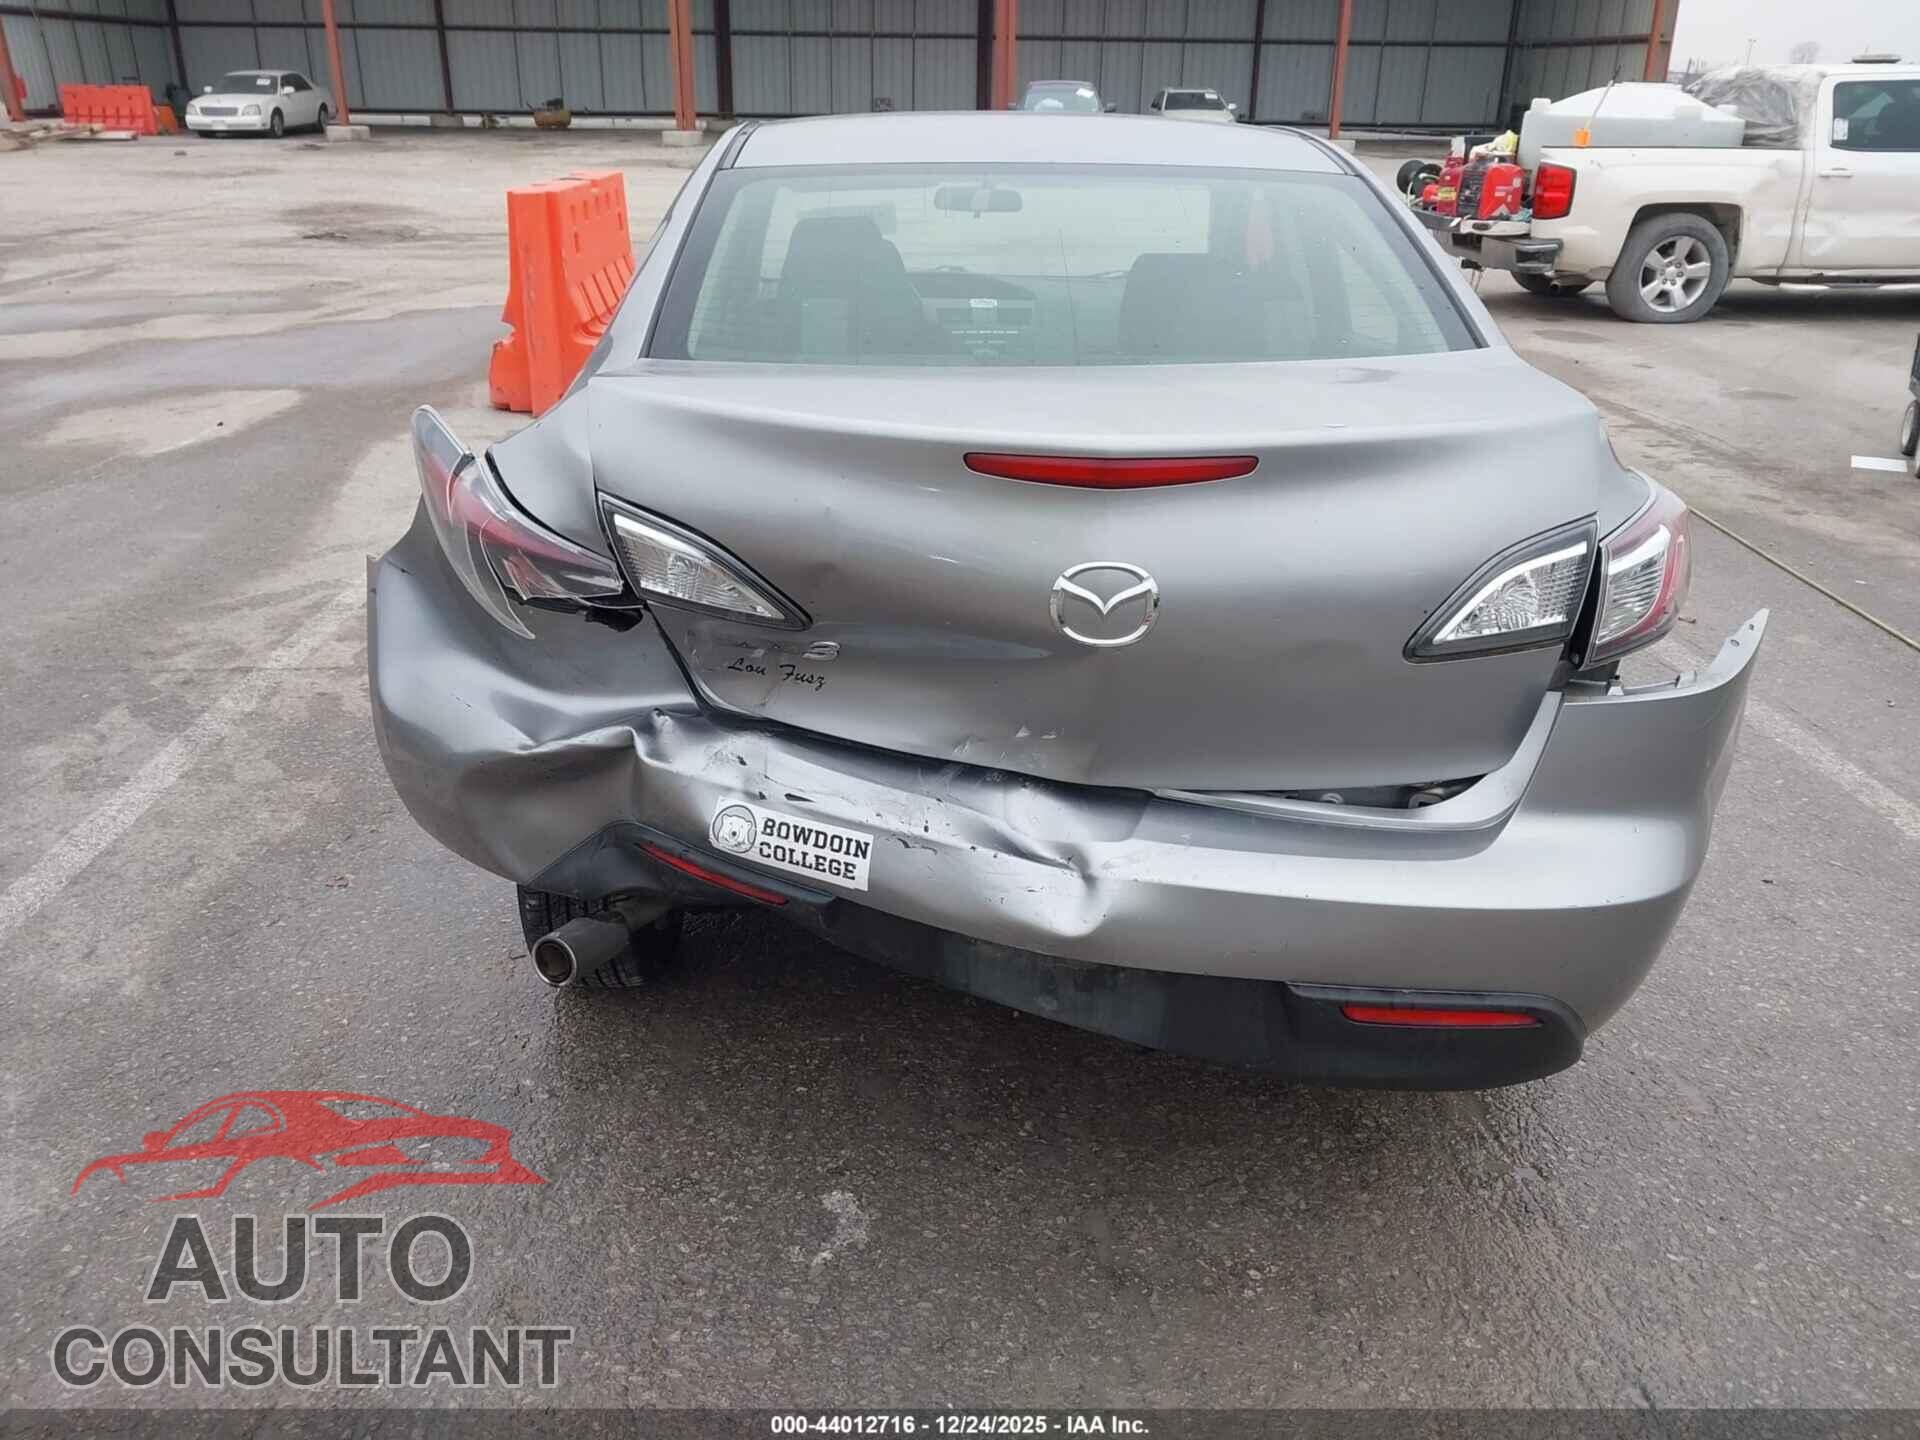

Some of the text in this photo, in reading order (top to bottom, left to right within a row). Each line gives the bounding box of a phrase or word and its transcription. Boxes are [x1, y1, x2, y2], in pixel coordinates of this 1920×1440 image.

[727, 657, 827, 692] Lou Fusz
[761, 817, 870, 860] BOWDOIN
[759, 841, 857, 881] COLLEGE
